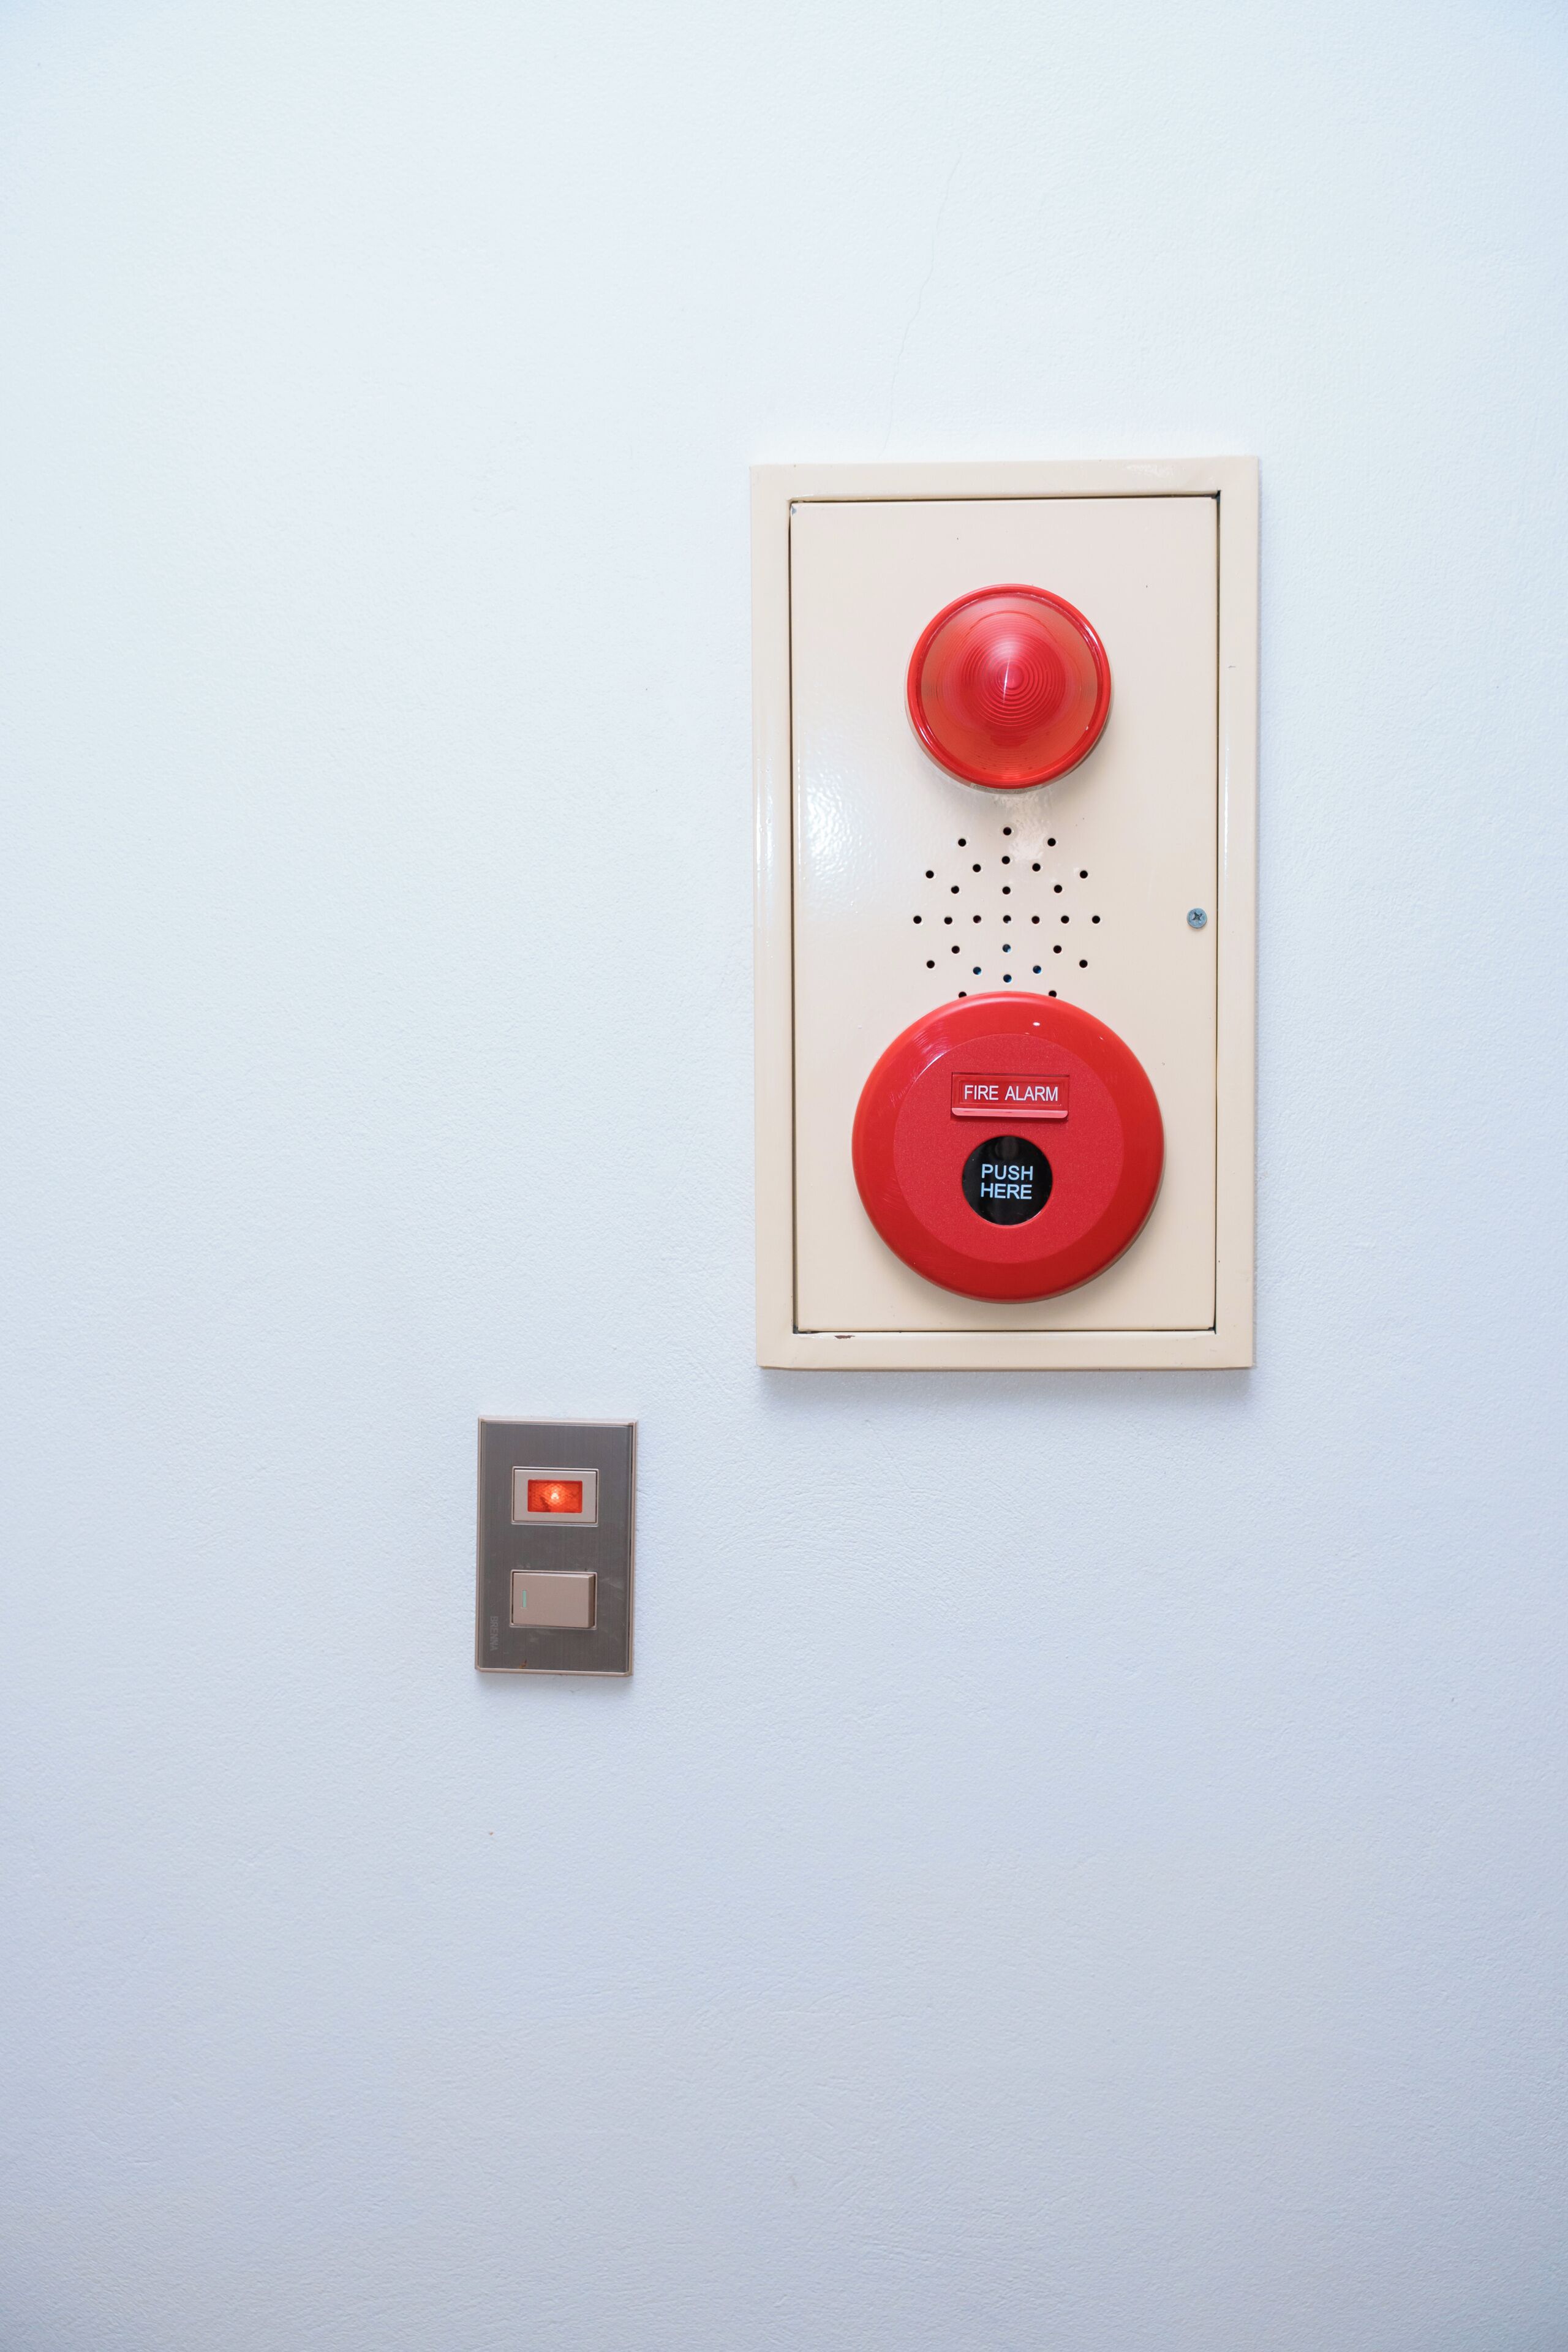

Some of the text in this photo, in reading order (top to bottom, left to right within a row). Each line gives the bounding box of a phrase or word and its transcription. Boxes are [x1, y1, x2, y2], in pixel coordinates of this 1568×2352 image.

[964, 1085, 1058, 1101] FIRE ALARM
[981, 1164, 1033, 1181] PUSH
[981, 1182, 1033, 1200] HERE
[490, 1616, 500, 1651] BRENNA
